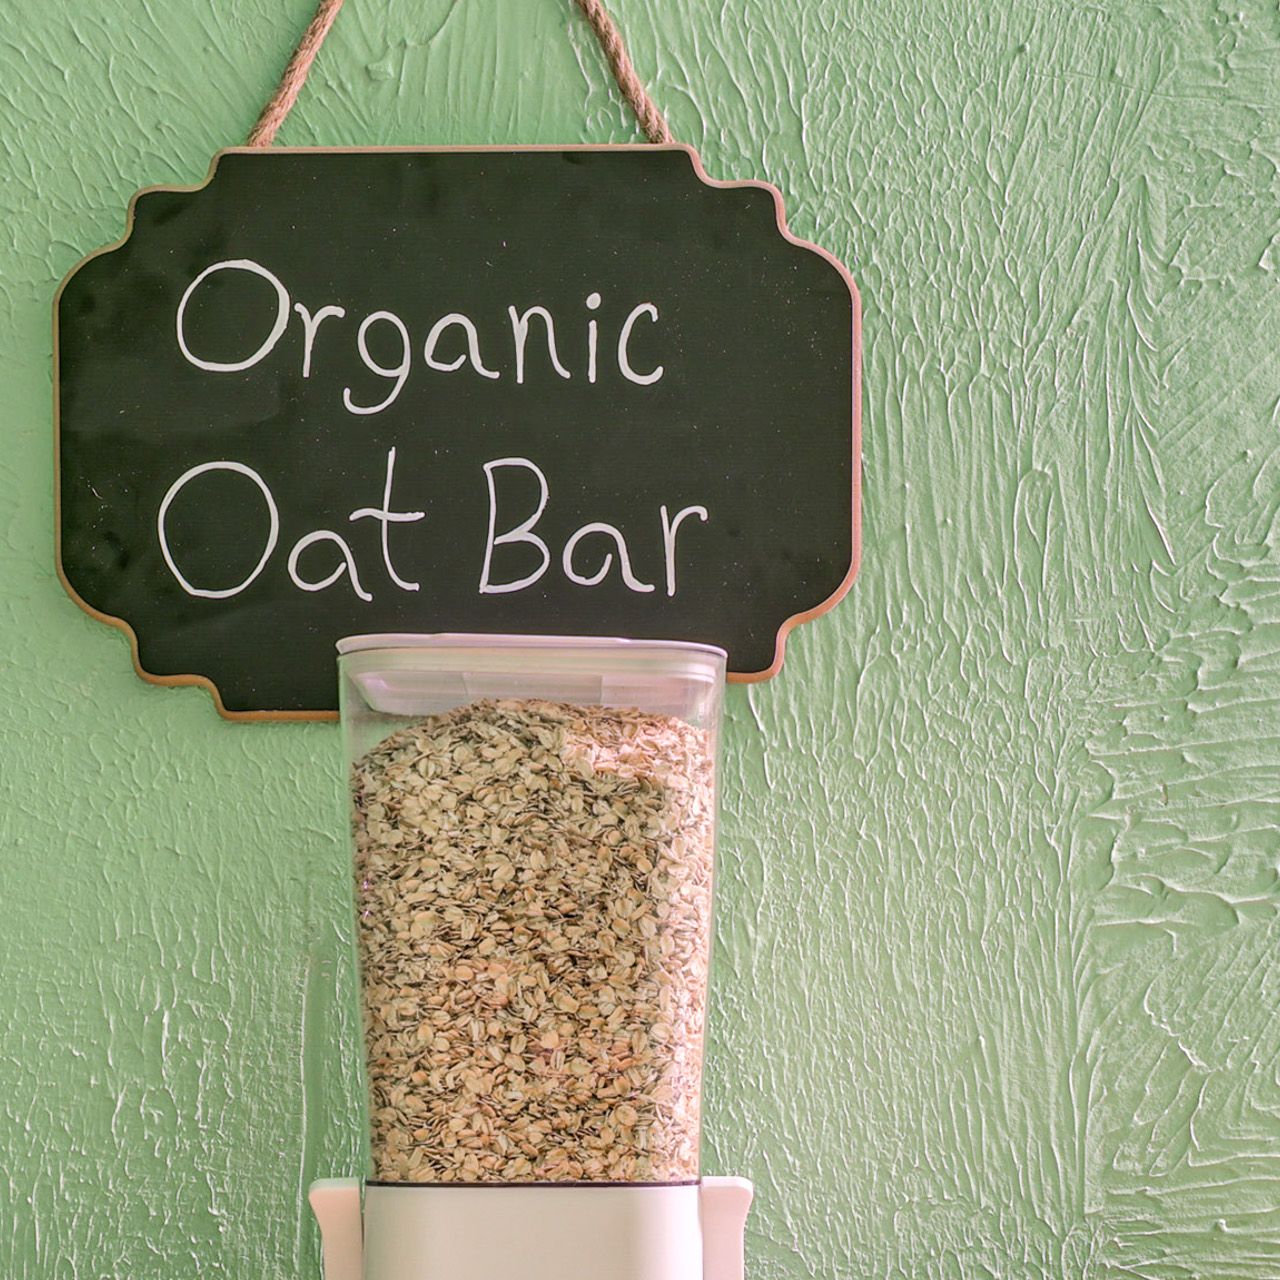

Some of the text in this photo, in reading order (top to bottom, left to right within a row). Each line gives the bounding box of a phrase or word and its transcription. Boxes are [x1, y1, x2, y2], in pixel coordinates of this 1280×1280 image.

[177, 259, 664, 415] Organic
[158, 446, 708, 602] Oat Bar
